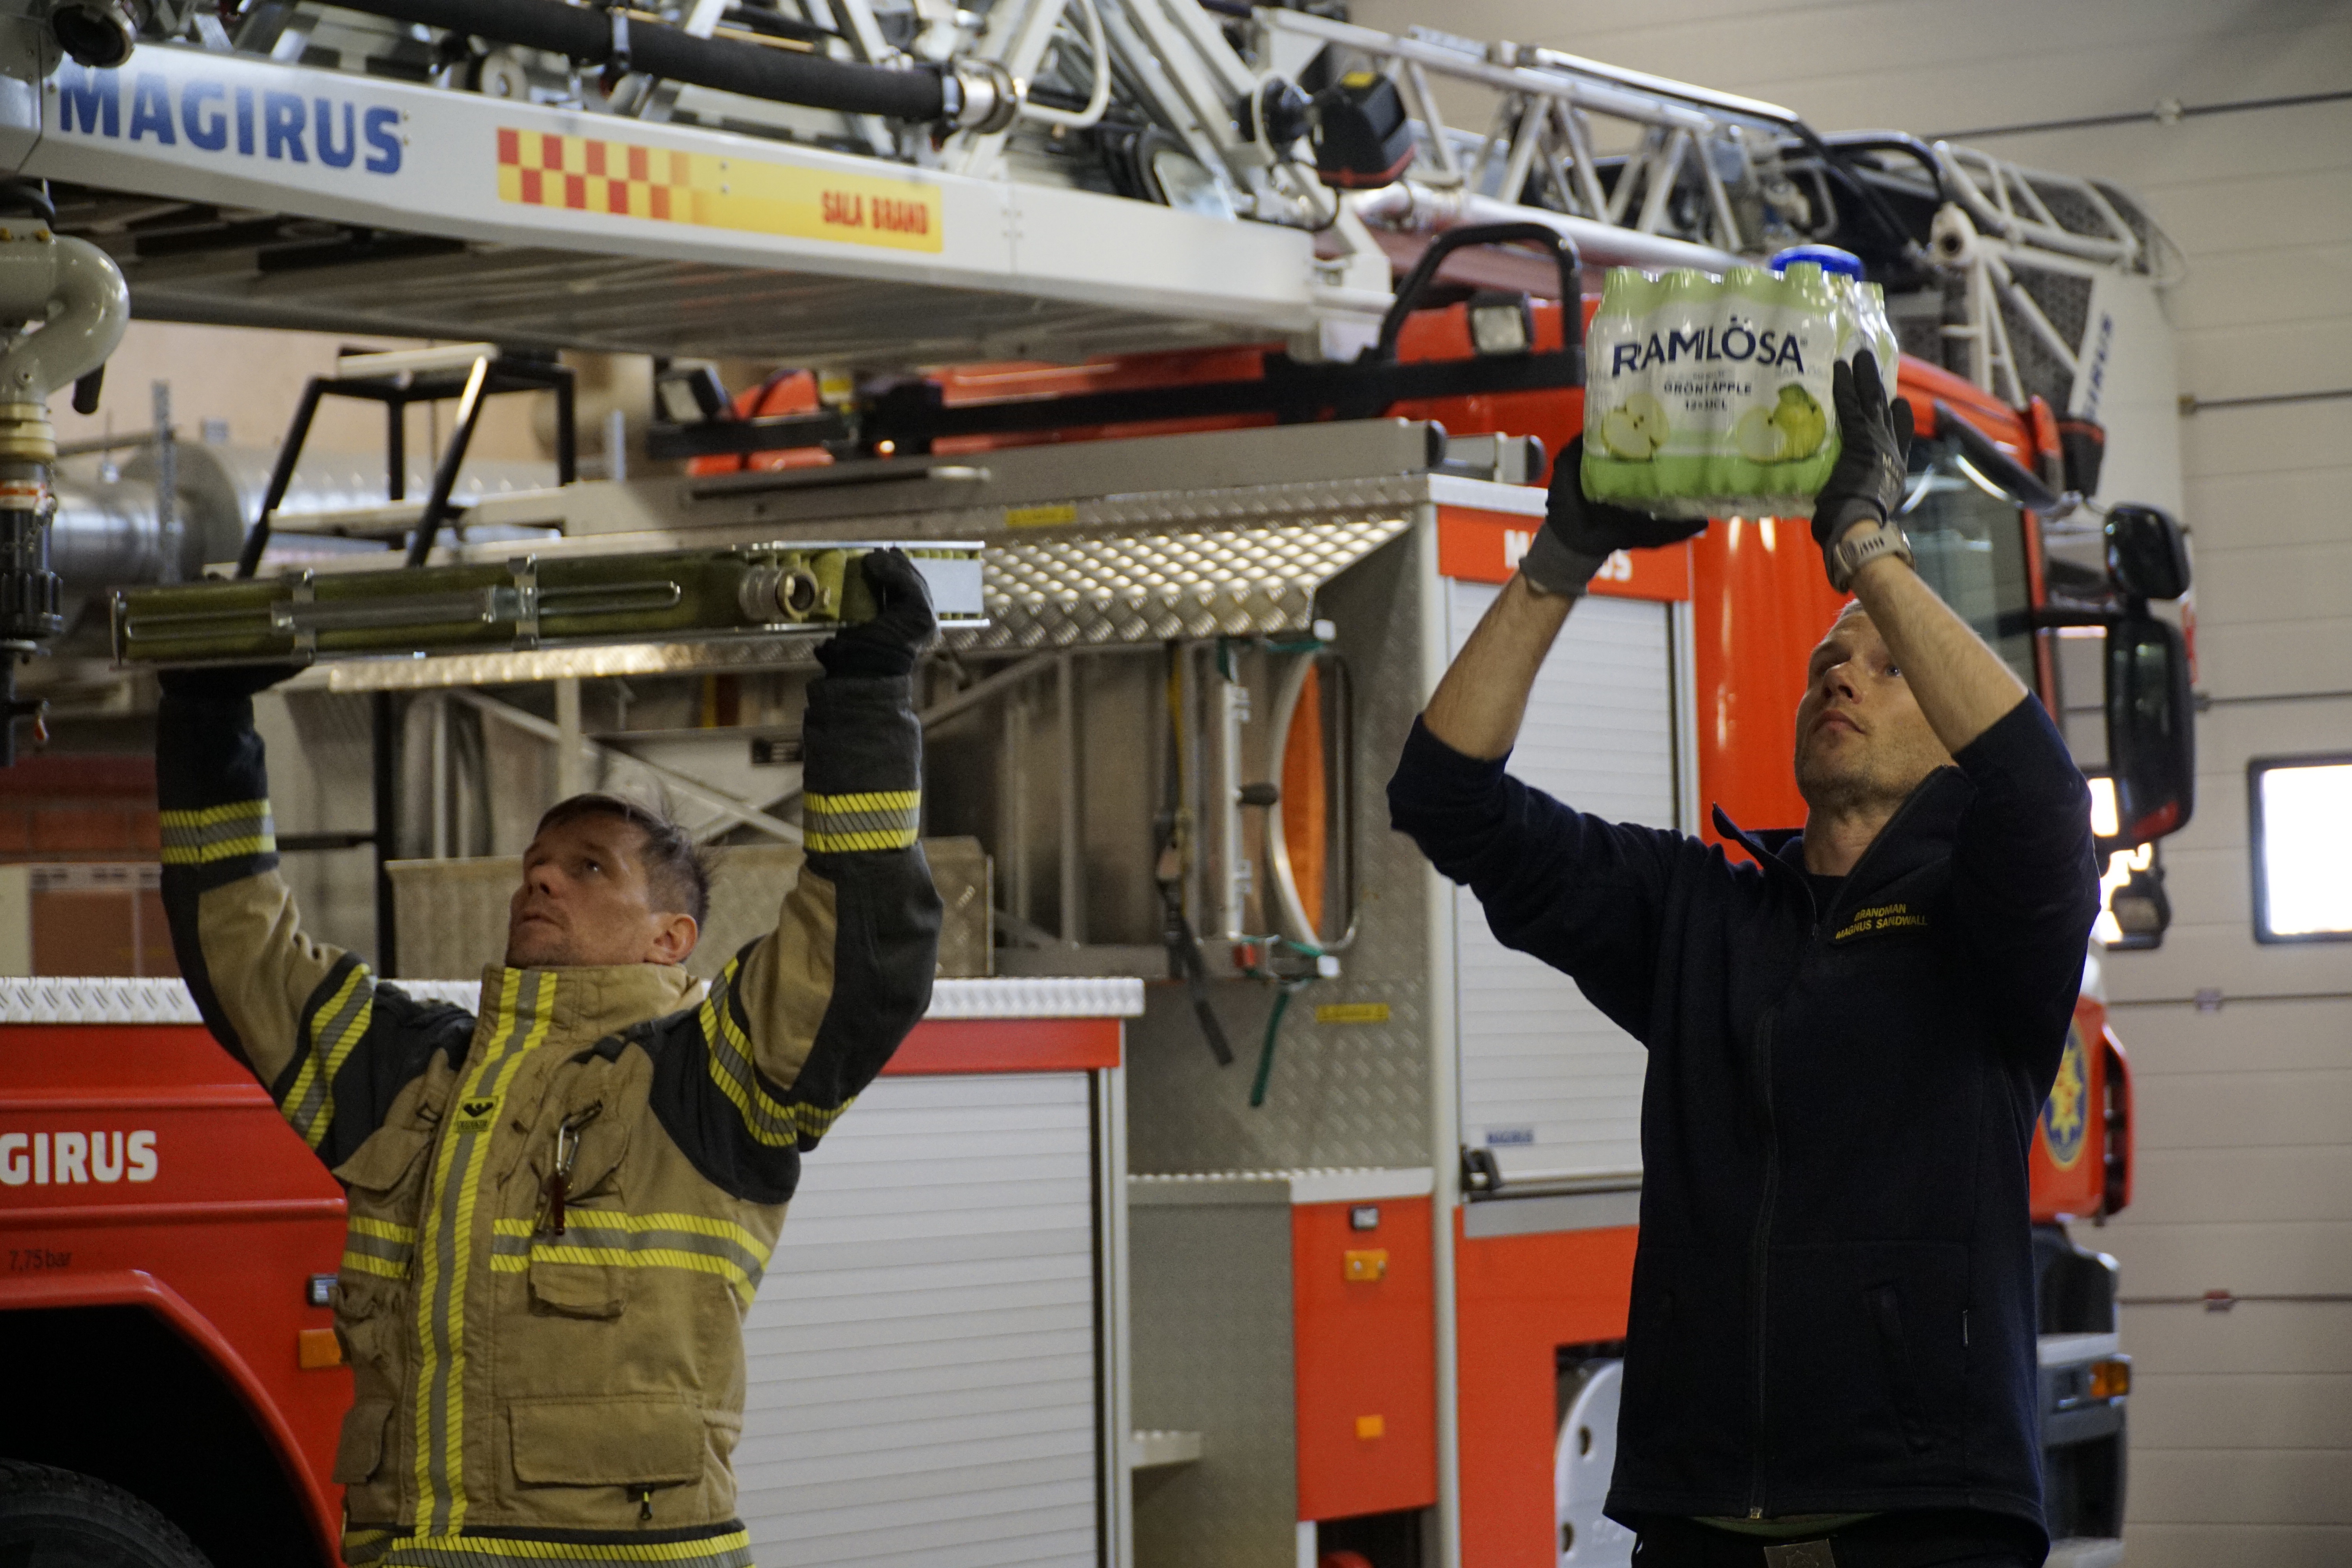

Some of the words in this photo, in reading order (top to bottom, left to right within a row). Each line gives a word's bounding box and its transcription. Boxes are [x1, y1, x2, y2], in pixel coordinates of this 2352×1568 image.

[60, 66, 401, 175] MAGIRUS
[822, 191, 864, 226] SALA
[872, 197, 928, 234] BRAND
[1612, 315, 1804, 376] RAMLÖSA
[1835, 919, 1872, 940] MAGNUS
[1854, 903, 1906, 921] BRANDMAN
[0, 1130, 157, 1186] GIRUS
